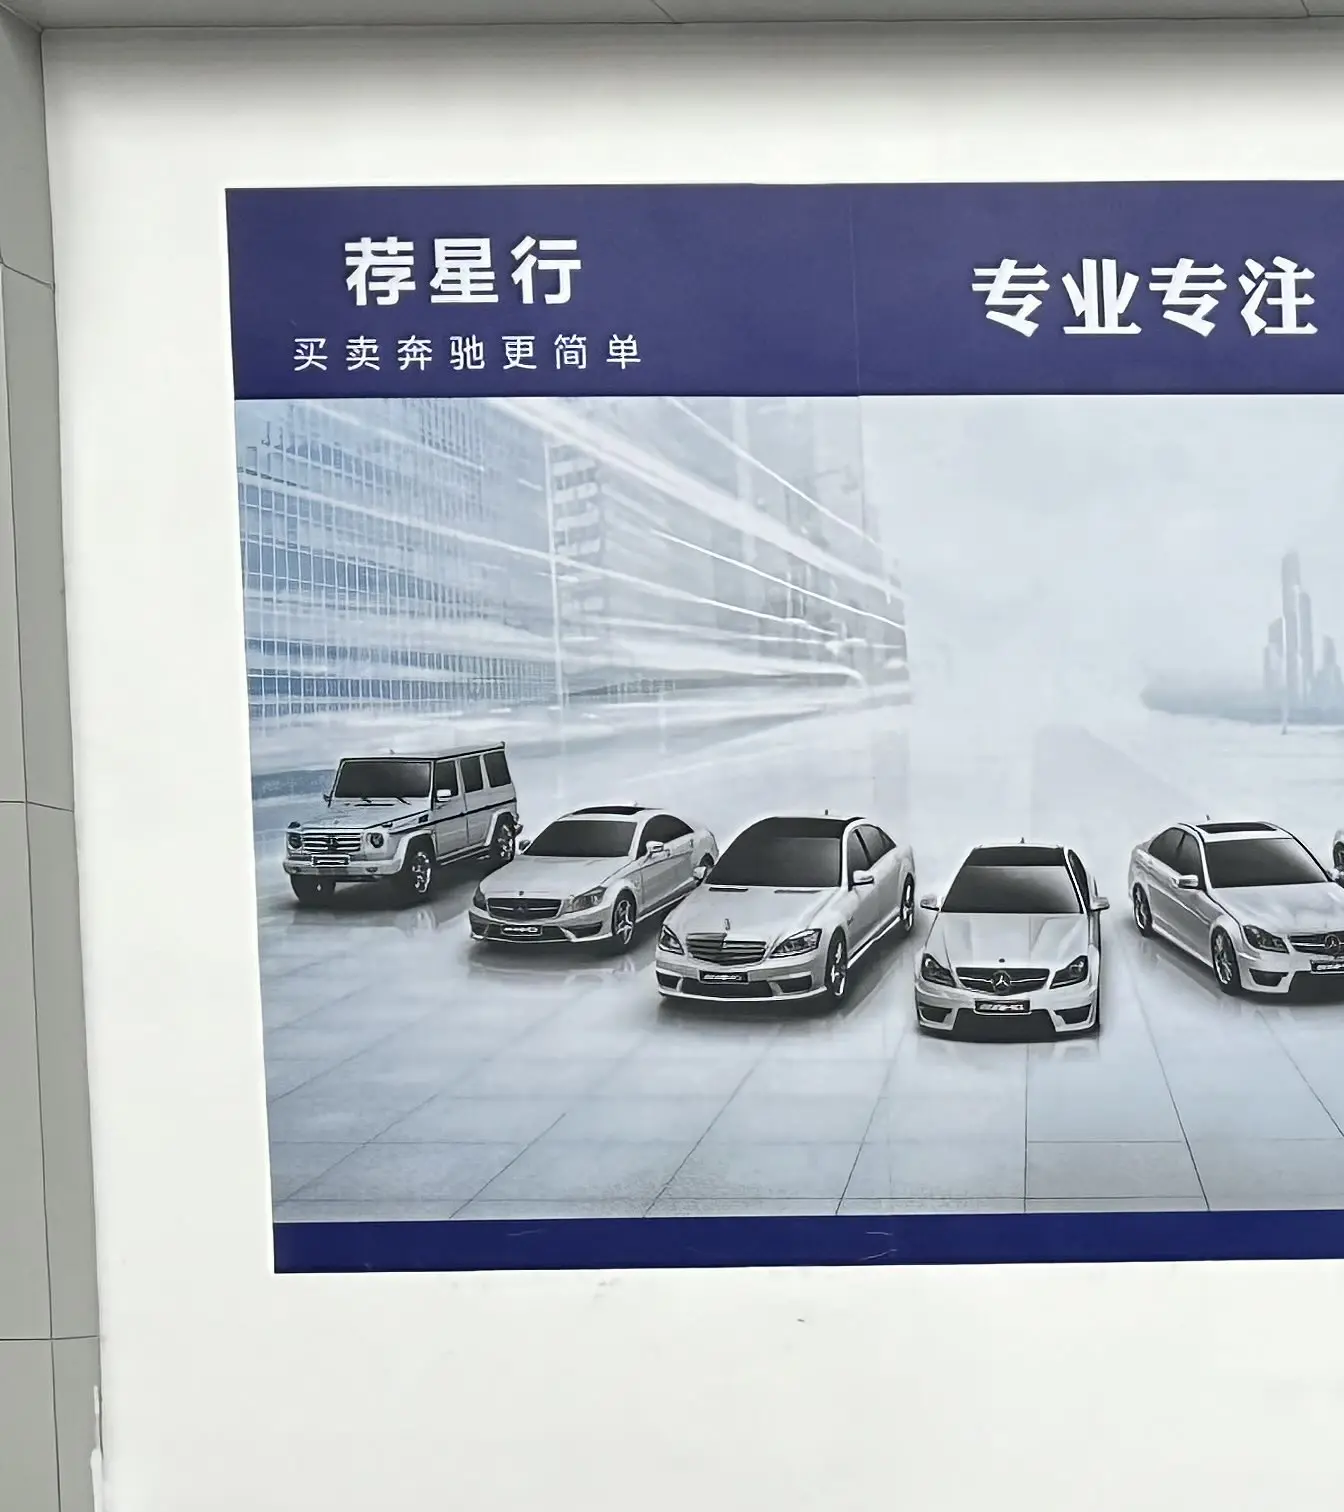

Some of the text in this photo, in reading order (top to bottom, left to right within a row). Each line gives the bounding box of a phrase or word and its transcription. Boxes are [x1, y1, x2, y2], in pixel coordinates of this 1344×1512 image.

[344, 235, 582, 306] 荐星行
[971, 256, 1318, 338] 专业专注
[293, 334, 642, 371] 买卖奔驰更简单
